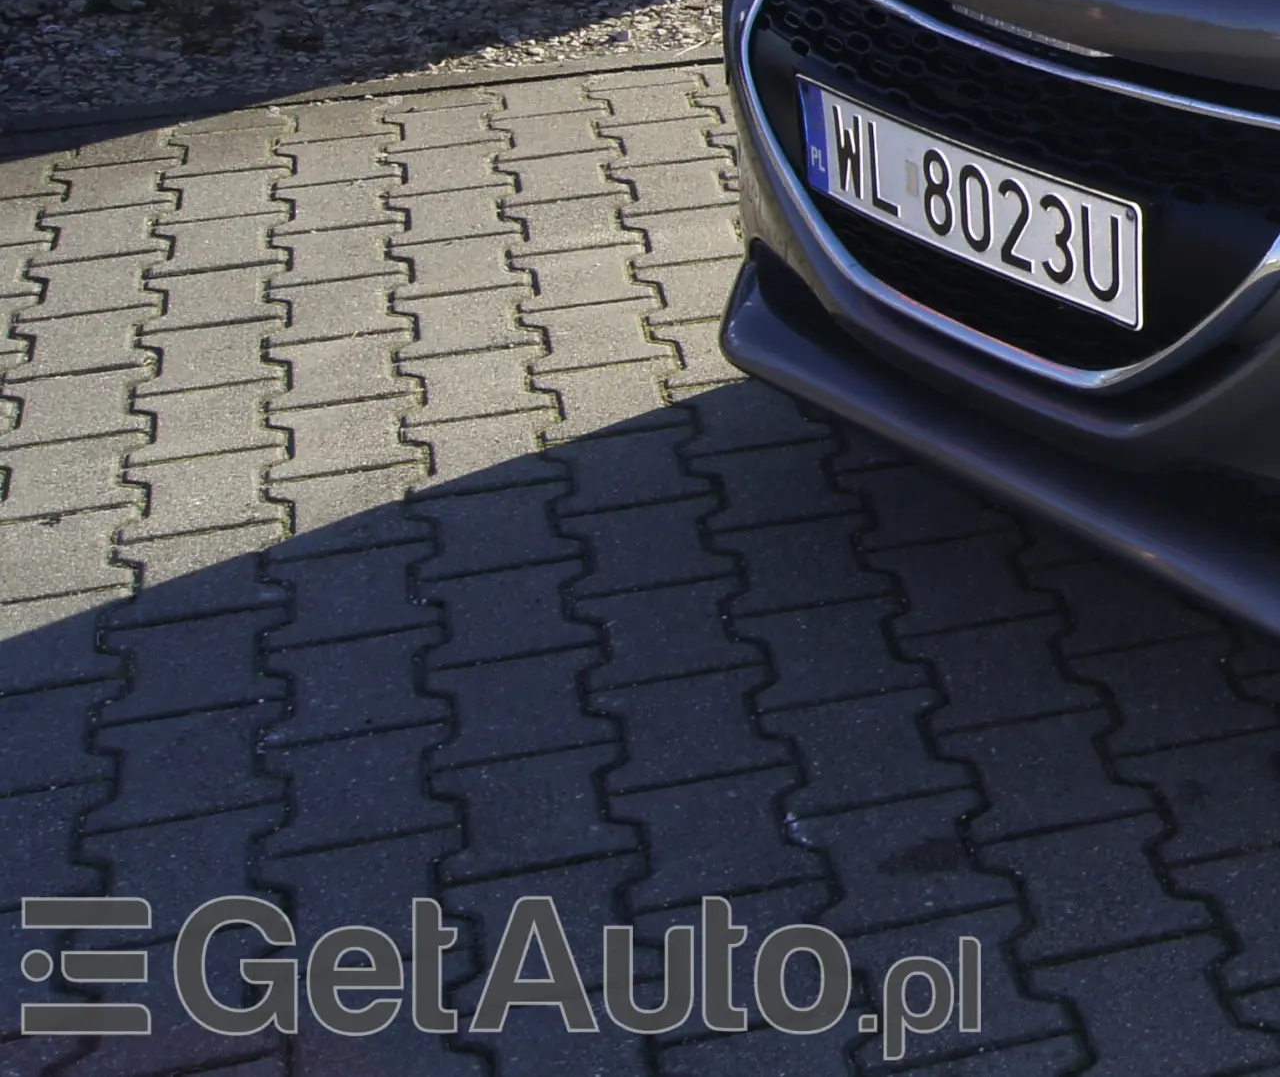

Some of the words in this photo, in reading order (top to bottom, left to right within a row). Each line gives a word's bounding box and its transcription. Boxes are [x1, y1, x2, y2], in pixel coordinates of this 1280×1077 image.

[809, 145, 827, 173] PL
[831, 103, 901, 219] WL
[922, 147, 1123, 303] 8023U
